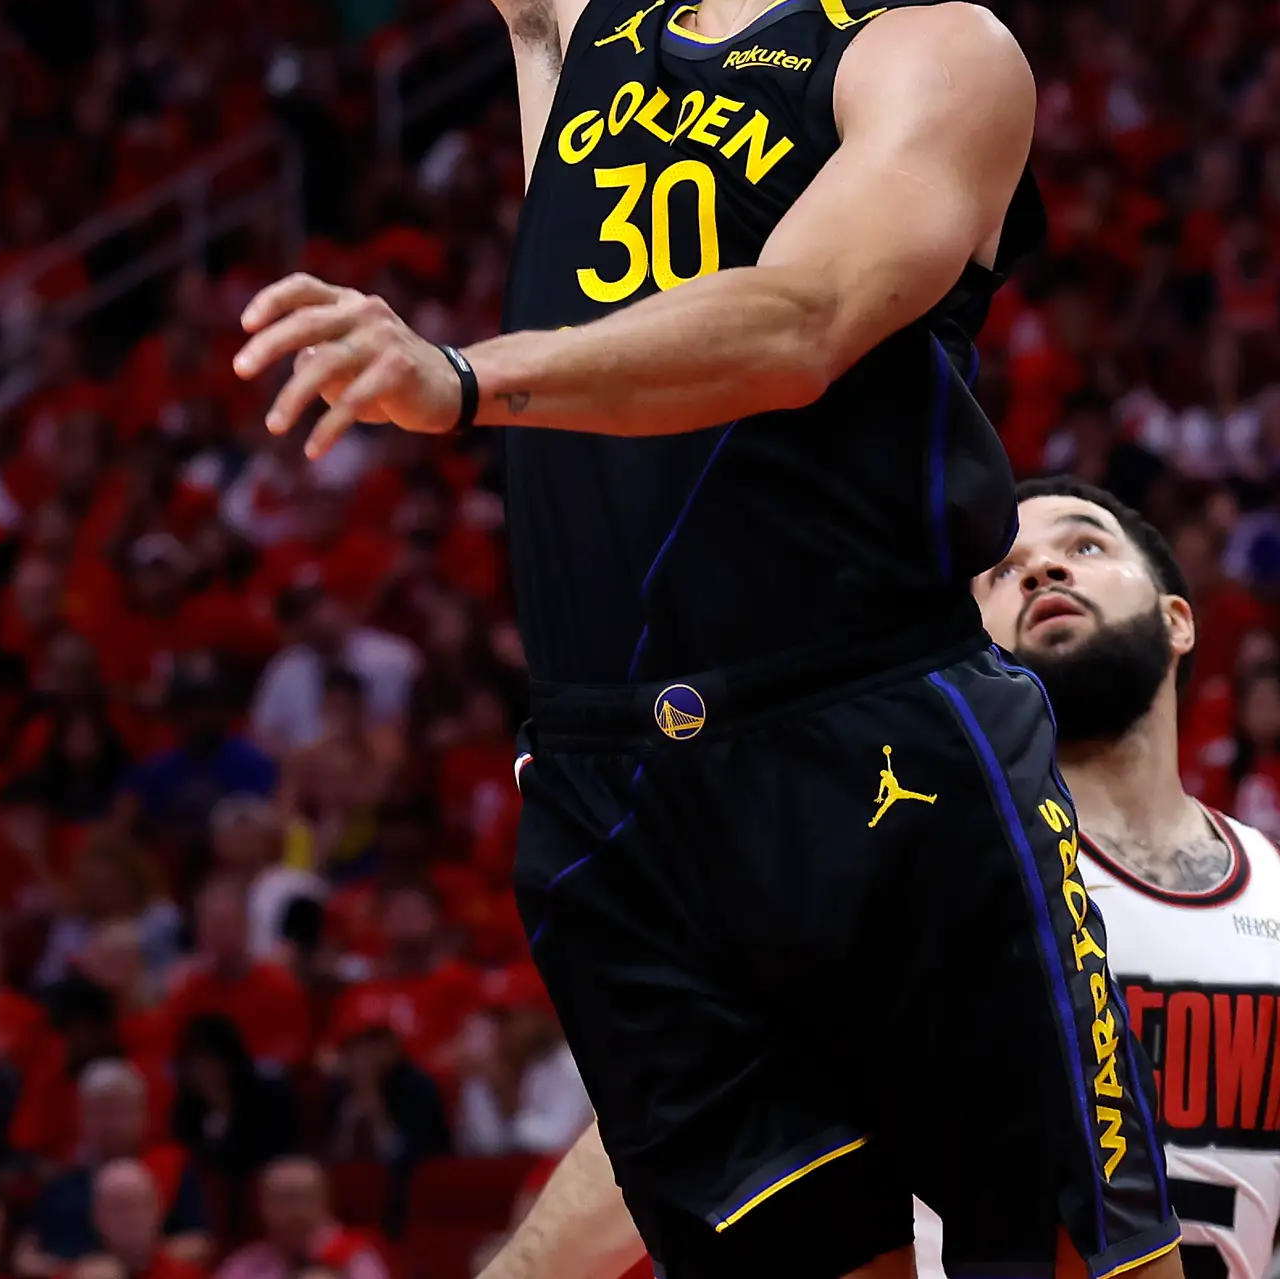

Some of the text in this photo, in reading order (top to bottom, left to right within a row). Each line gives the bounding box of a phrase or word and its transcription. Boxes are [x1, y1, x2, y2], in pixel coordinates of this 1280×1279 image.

[722, 44, 812, 71] Rakuten
[558, 81, 794, 185] GOLDEN
[576, 159, 720, 303] 30
[1036, 797, 1129, 1184] WARRIORS
